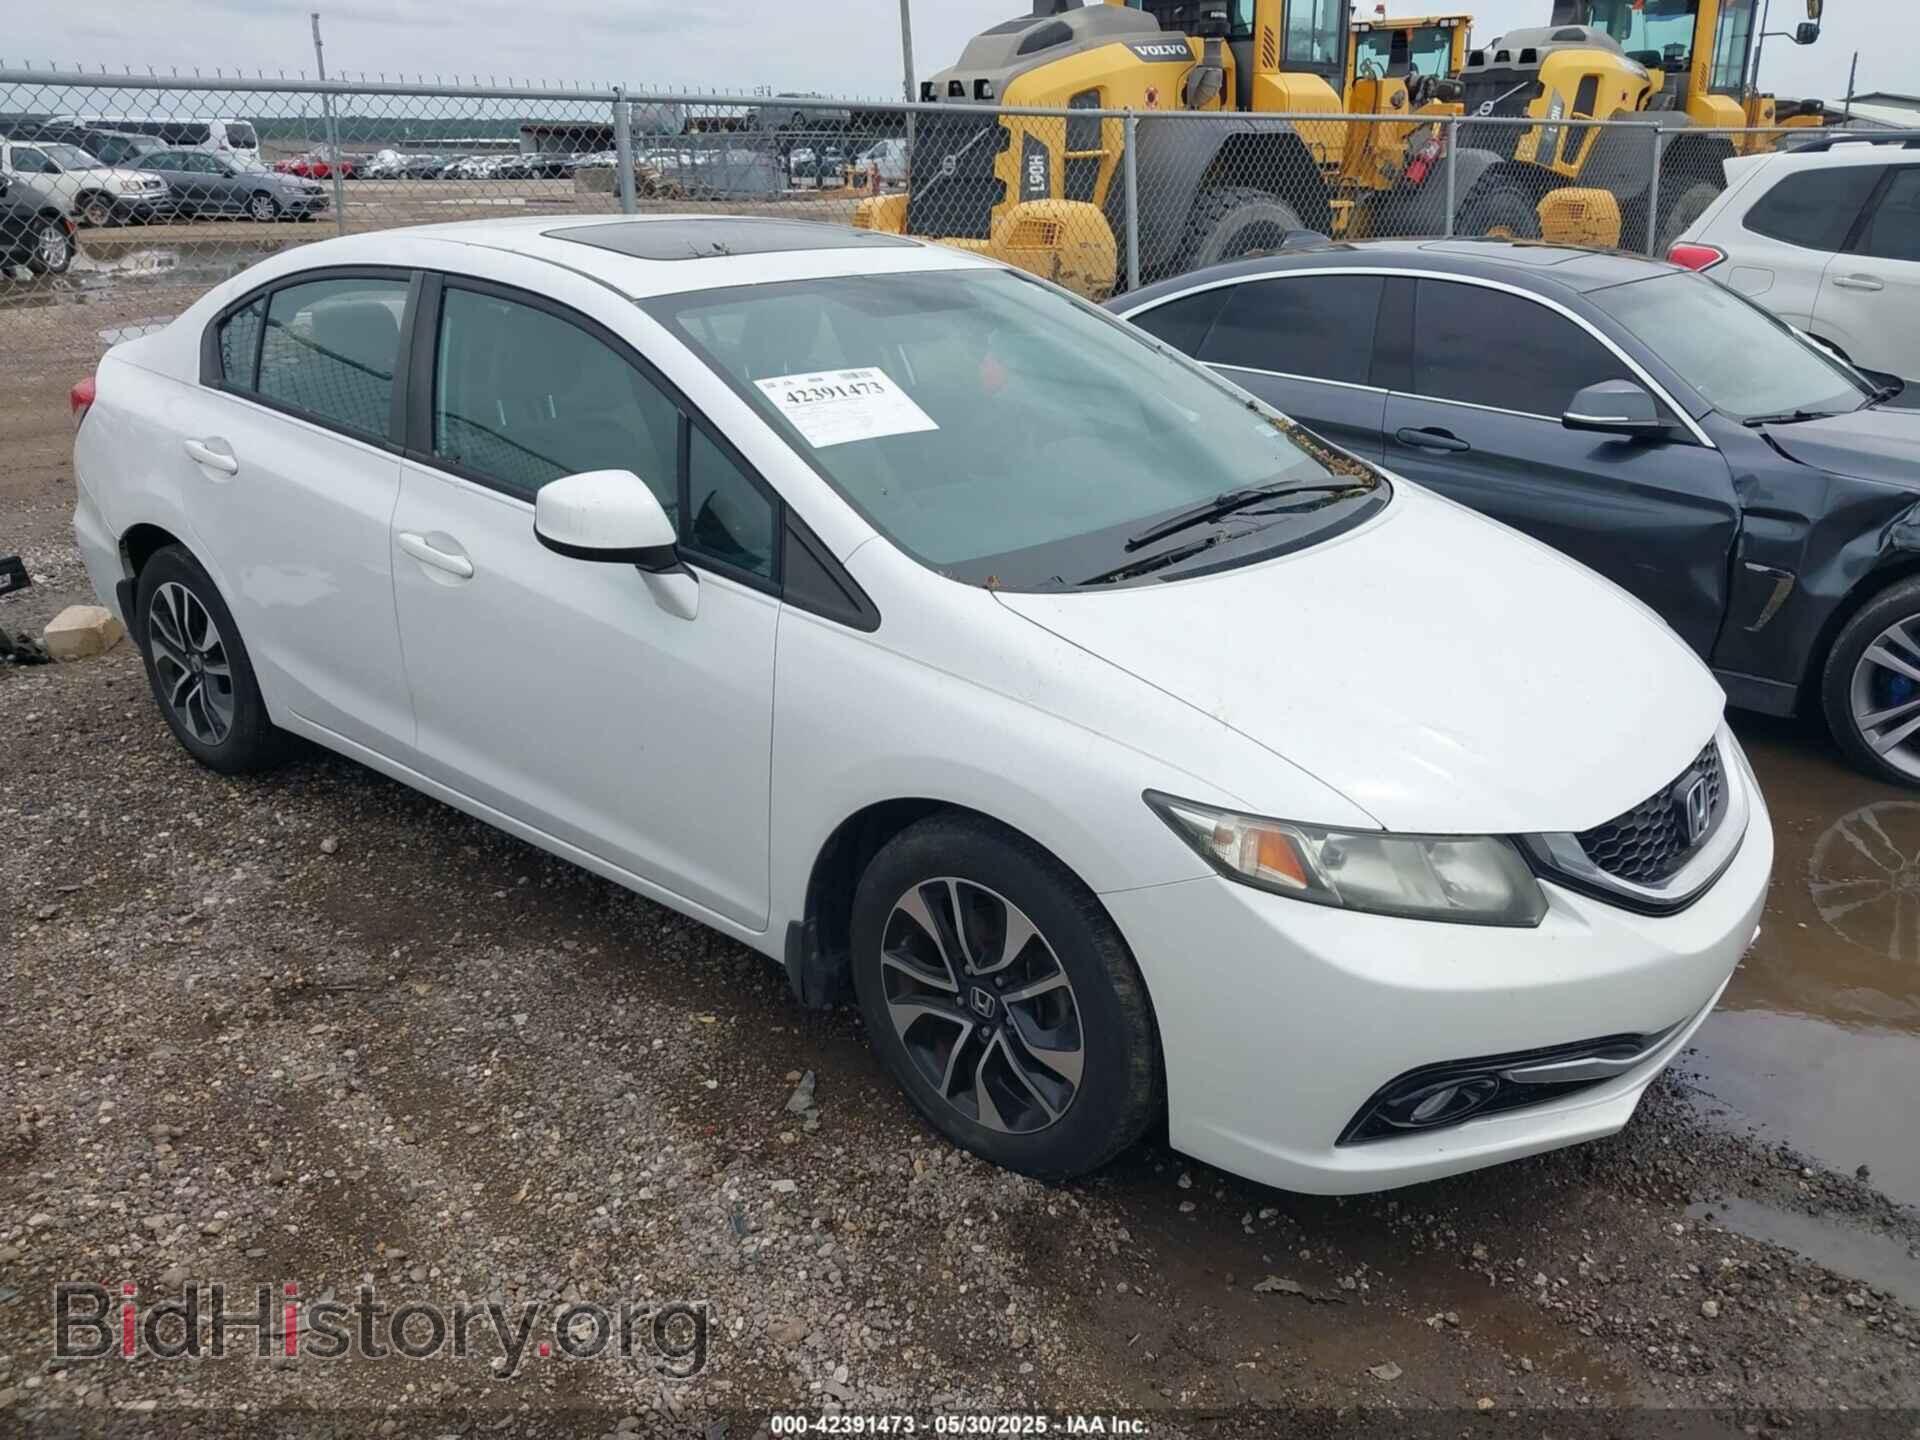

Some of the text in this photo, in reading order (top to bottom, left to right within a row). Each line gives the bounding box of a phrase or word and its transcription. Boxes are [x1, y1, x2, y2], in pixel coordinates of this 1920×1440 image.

[1134, 44, 1187, 56] VOLVO
[1029, 154, 1045, 192] L90H
[786, 381, 885, 404] 42391473
